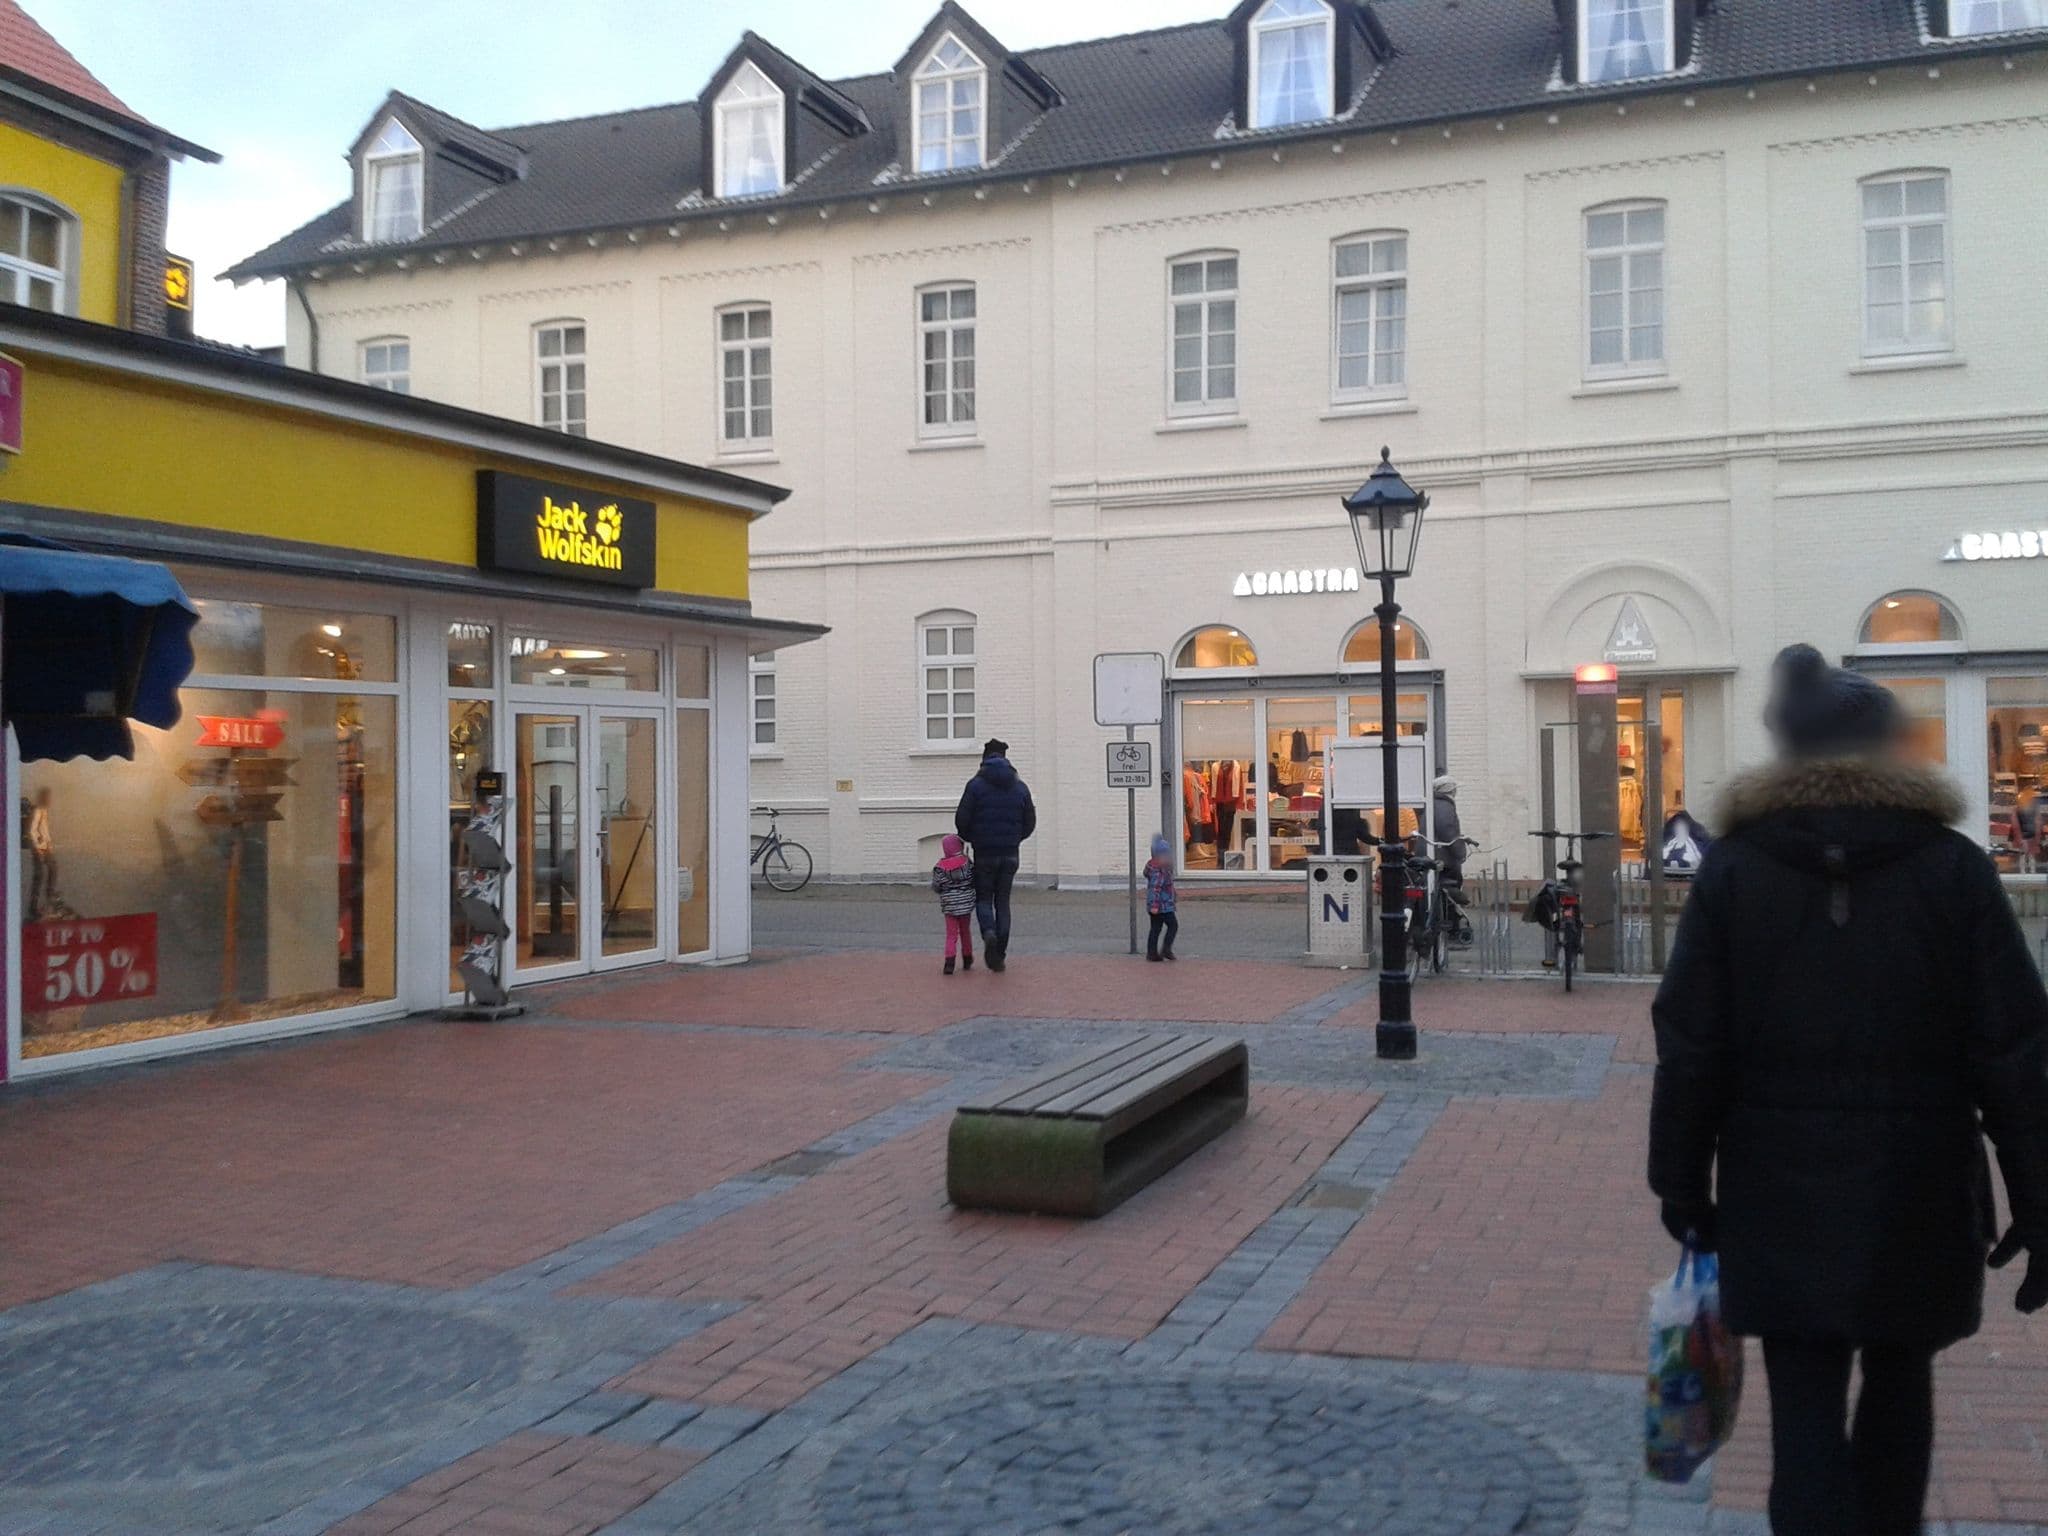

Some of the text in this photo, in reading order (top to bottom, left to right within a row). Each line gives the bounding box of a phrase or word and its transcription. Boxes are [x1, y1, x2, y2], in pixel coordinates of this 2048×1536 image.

[537, 496, 588, 534] Jack
[536, 527, 623, 570] Wolfskin
[219, 722, 264, 744] SALE
[45, 924, 105, 948] UP TO
